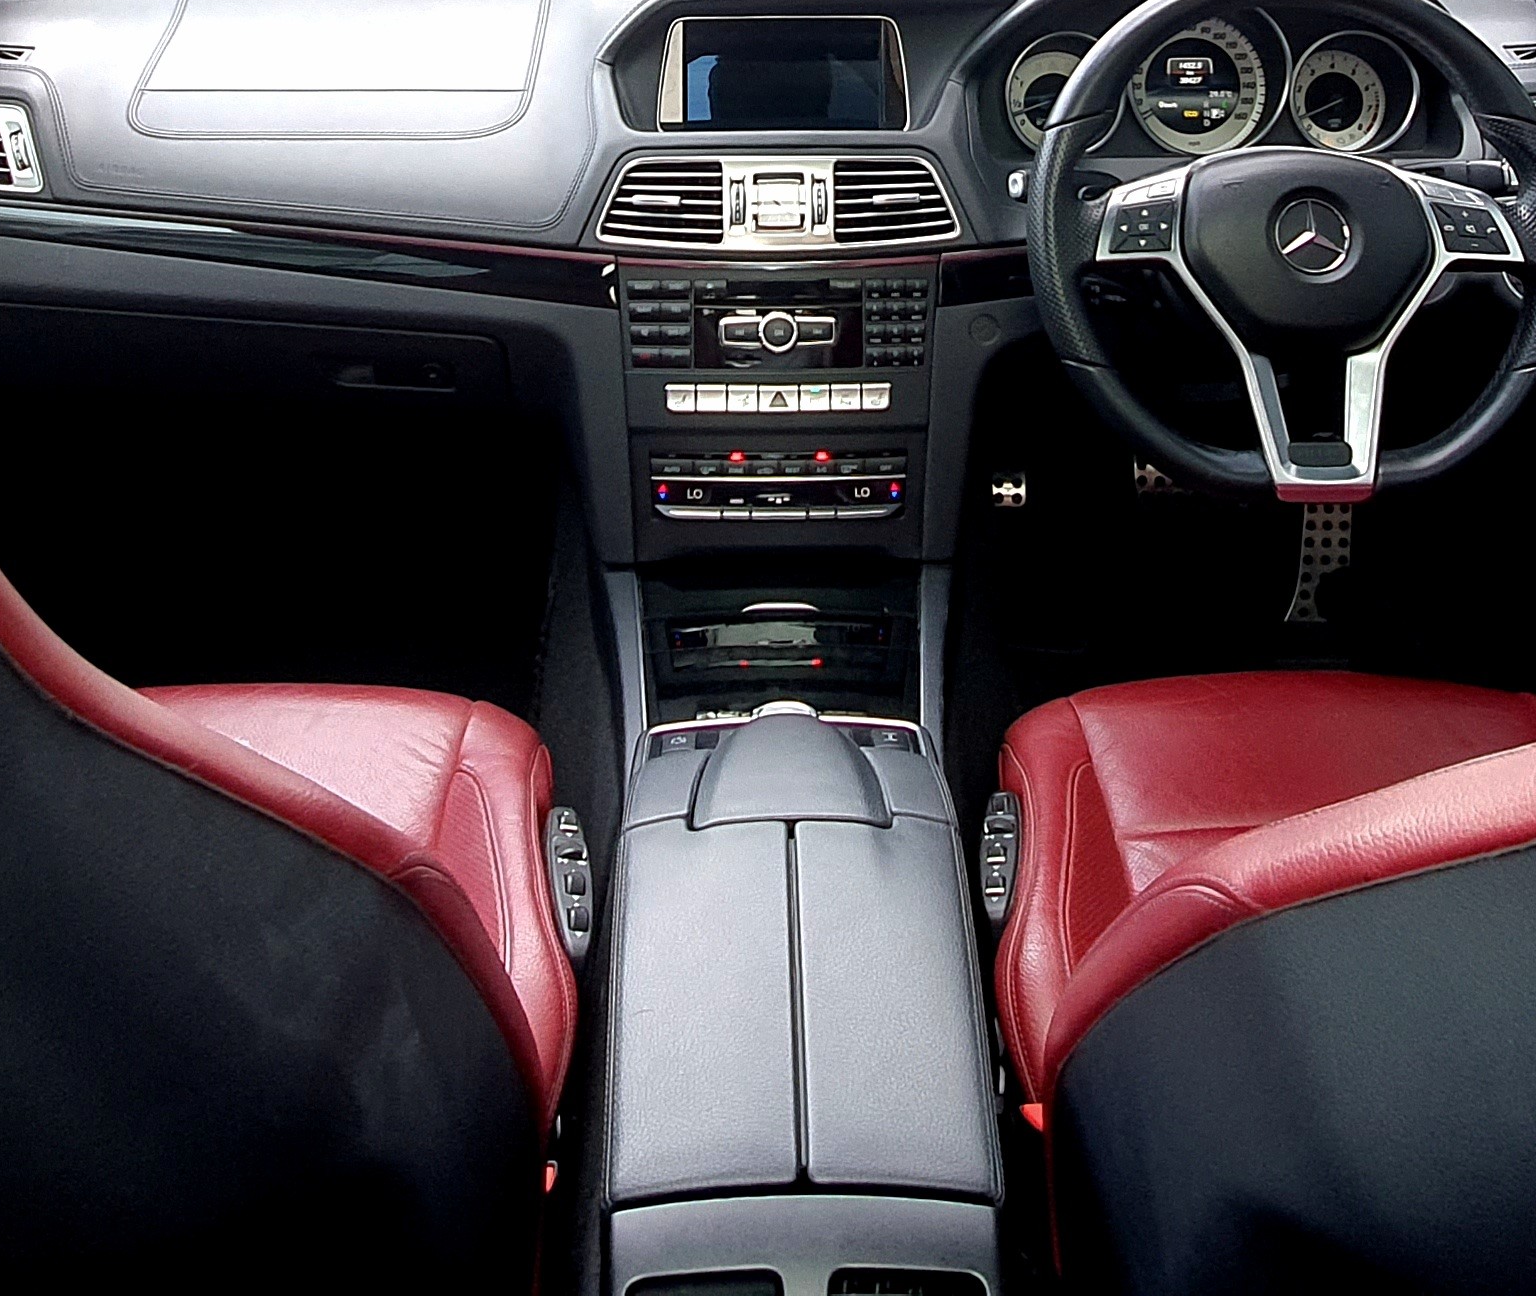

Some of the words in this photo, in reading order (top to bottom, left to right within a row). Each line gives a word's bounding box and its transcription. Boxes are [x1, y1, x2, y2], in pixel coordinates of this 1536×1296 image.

[1213, 32, 1226, 40] 100
[1234, 52, 1248, 61] 120
[1243, 81, 1257, 90] 140
[1234, 112, 1248, 121] 160
[686, 487, 704, 500] LO
[854, 486, 871, 499] LO
